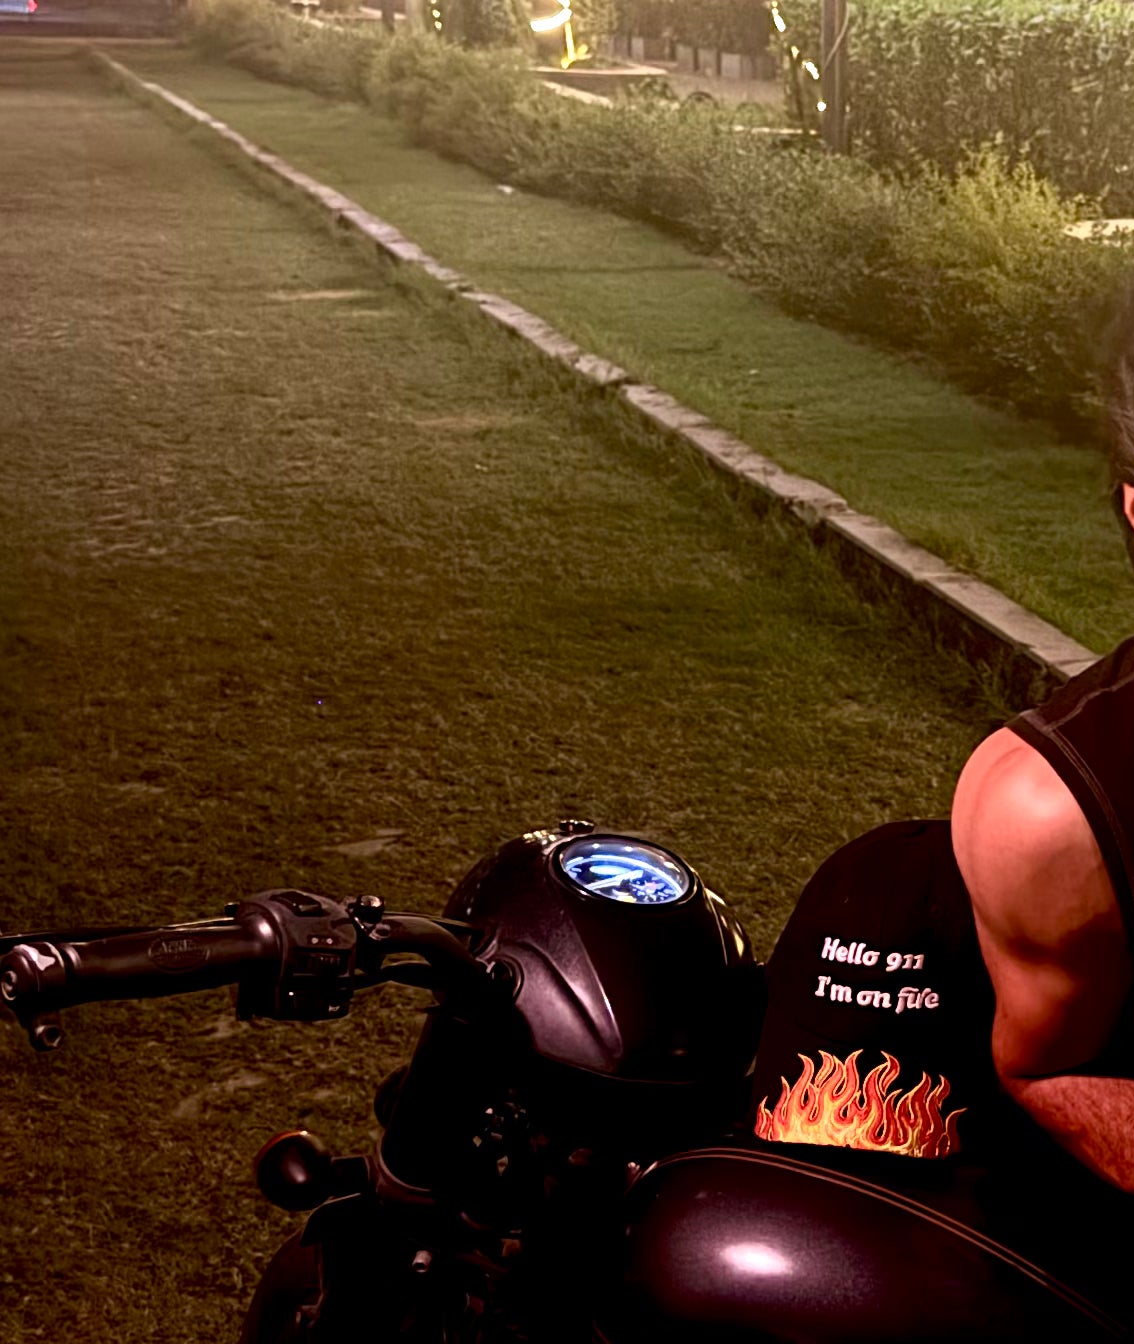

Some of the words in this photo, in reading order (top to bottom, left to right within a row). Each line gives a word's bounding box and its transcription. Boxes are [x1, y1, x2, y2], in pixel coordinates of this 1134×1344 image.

[821, 937, 880, 966] Hello
[885, 952, 925, 972] 911
[814, 975, 852, 1003] I'm
[856, 990, 892, 1008] on
[895, 986, 939, 1014] fire
